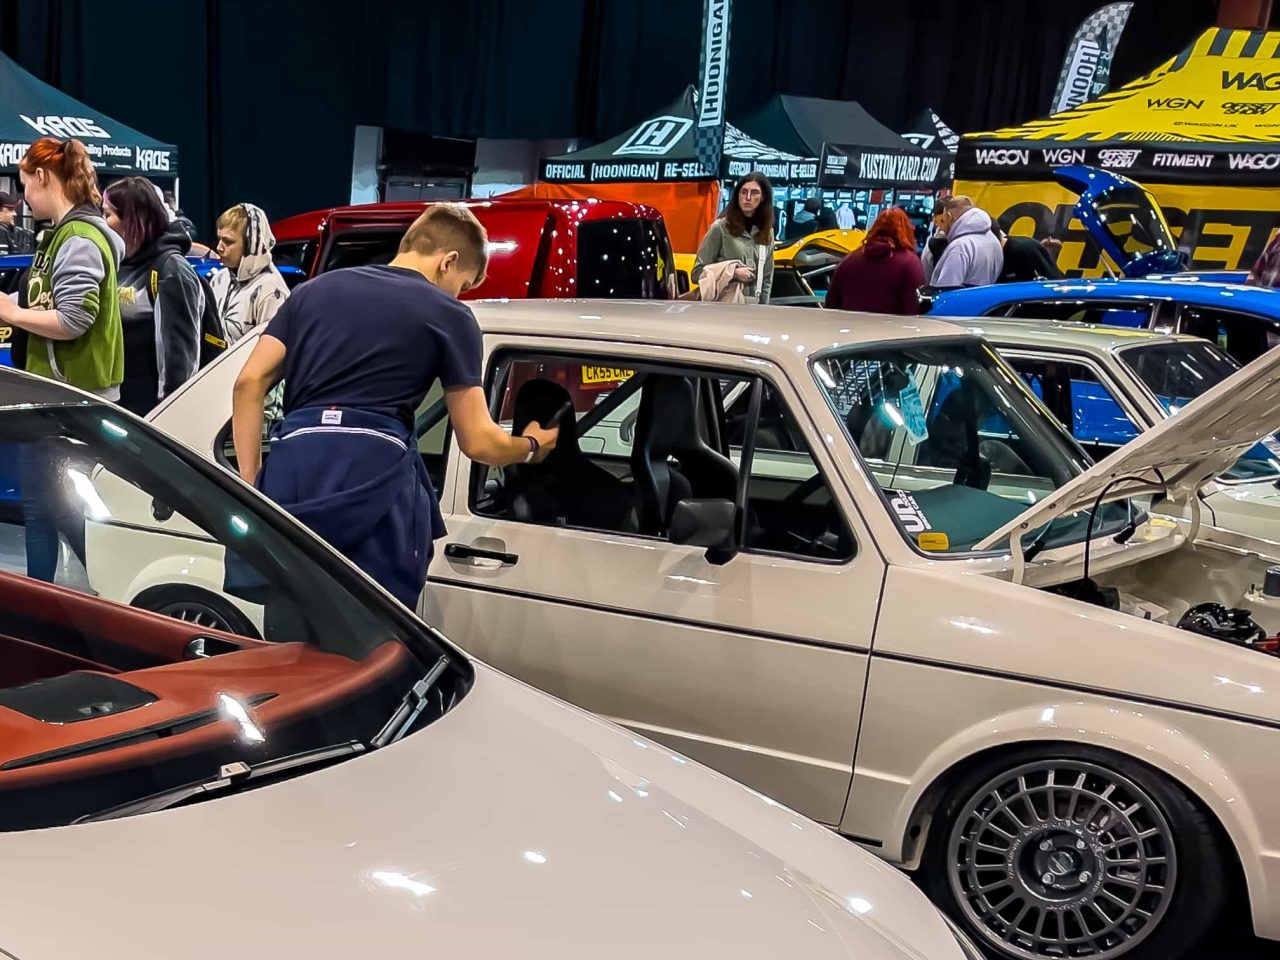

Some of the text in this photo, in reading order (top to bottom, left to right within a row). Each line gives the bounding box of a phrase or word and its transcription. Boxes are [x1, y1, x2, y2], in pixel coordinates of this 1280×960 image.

[1147, 98, 1205, 110] WGN
[19, 114, 112, 139] KAOS
[103, 144, 131, 157] Products
[136, 145, 170, 171] KAOS
[976, 149, 1029, 165] WAGON
[1043, 149, 1085, 164] WGN
[859, 153, 940, 182] KUSTOMYARD.COM
[1153, 153, 1214, 168] FITMENT
[546, 164, 585, 179] OFFICIAL
[591, 162, 659, 181] [HOONIGAN]
